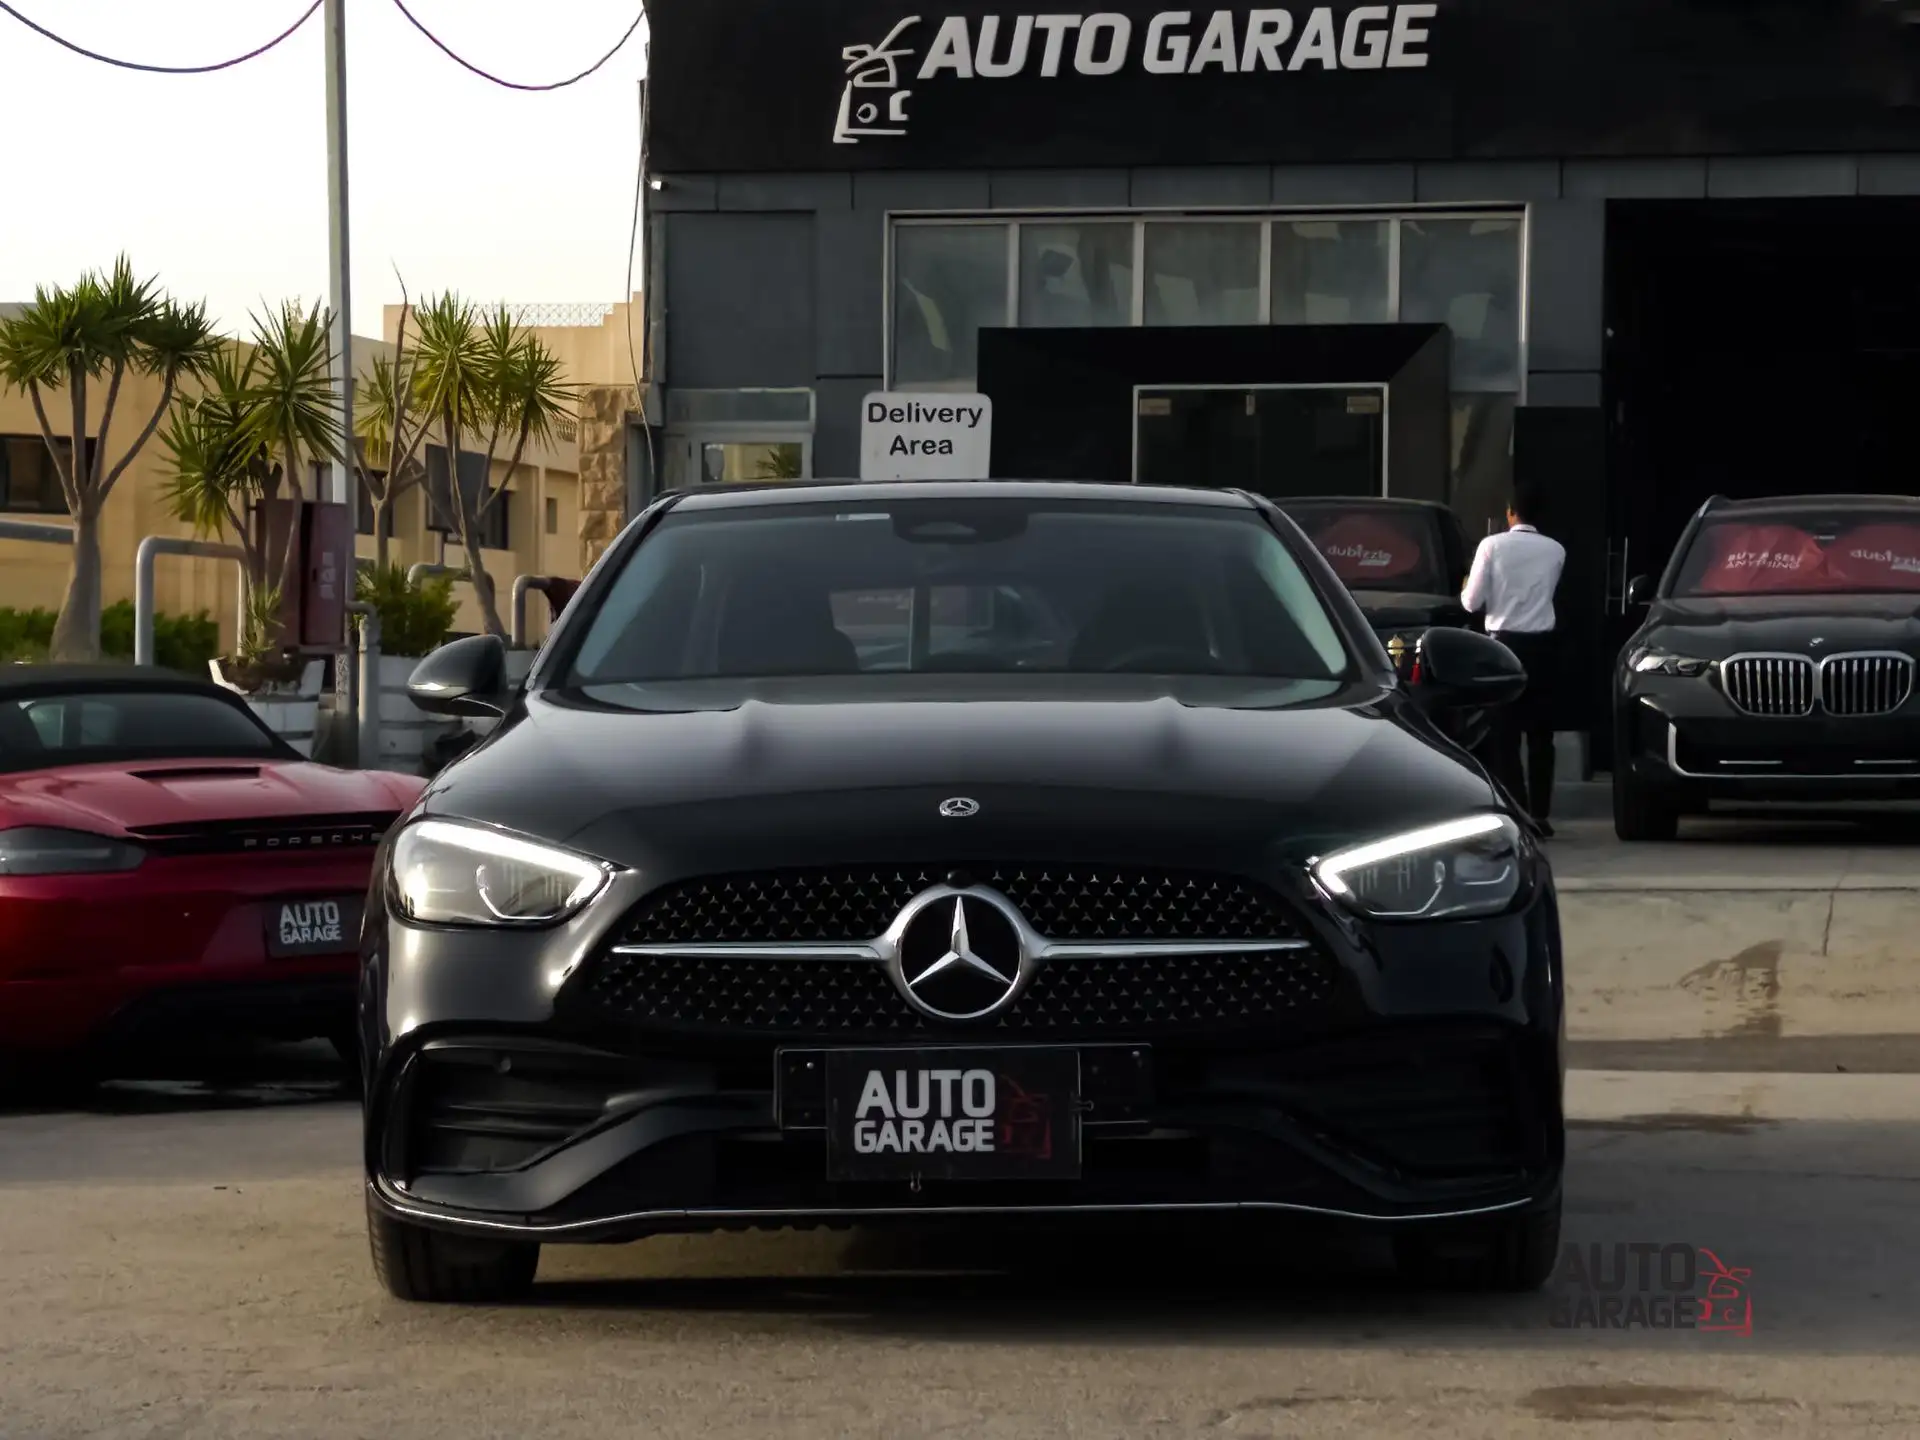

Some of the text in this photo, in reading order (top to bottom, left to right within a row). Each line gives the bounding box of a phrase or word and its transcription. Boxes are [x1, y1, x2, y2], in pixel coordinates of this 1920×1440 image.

[917, 3, 1438, 79] AUTO GARAGE
[868, 402, 983, 428] Delivery
[889, 434, 953, 456] Area
[280, 901, 340, 928] AUTO
[280, 924, 342, 944] GARAGE
[855, 1070, 995, 1119] AUTO
[854, 1119, 995, 1153] GARAGE
